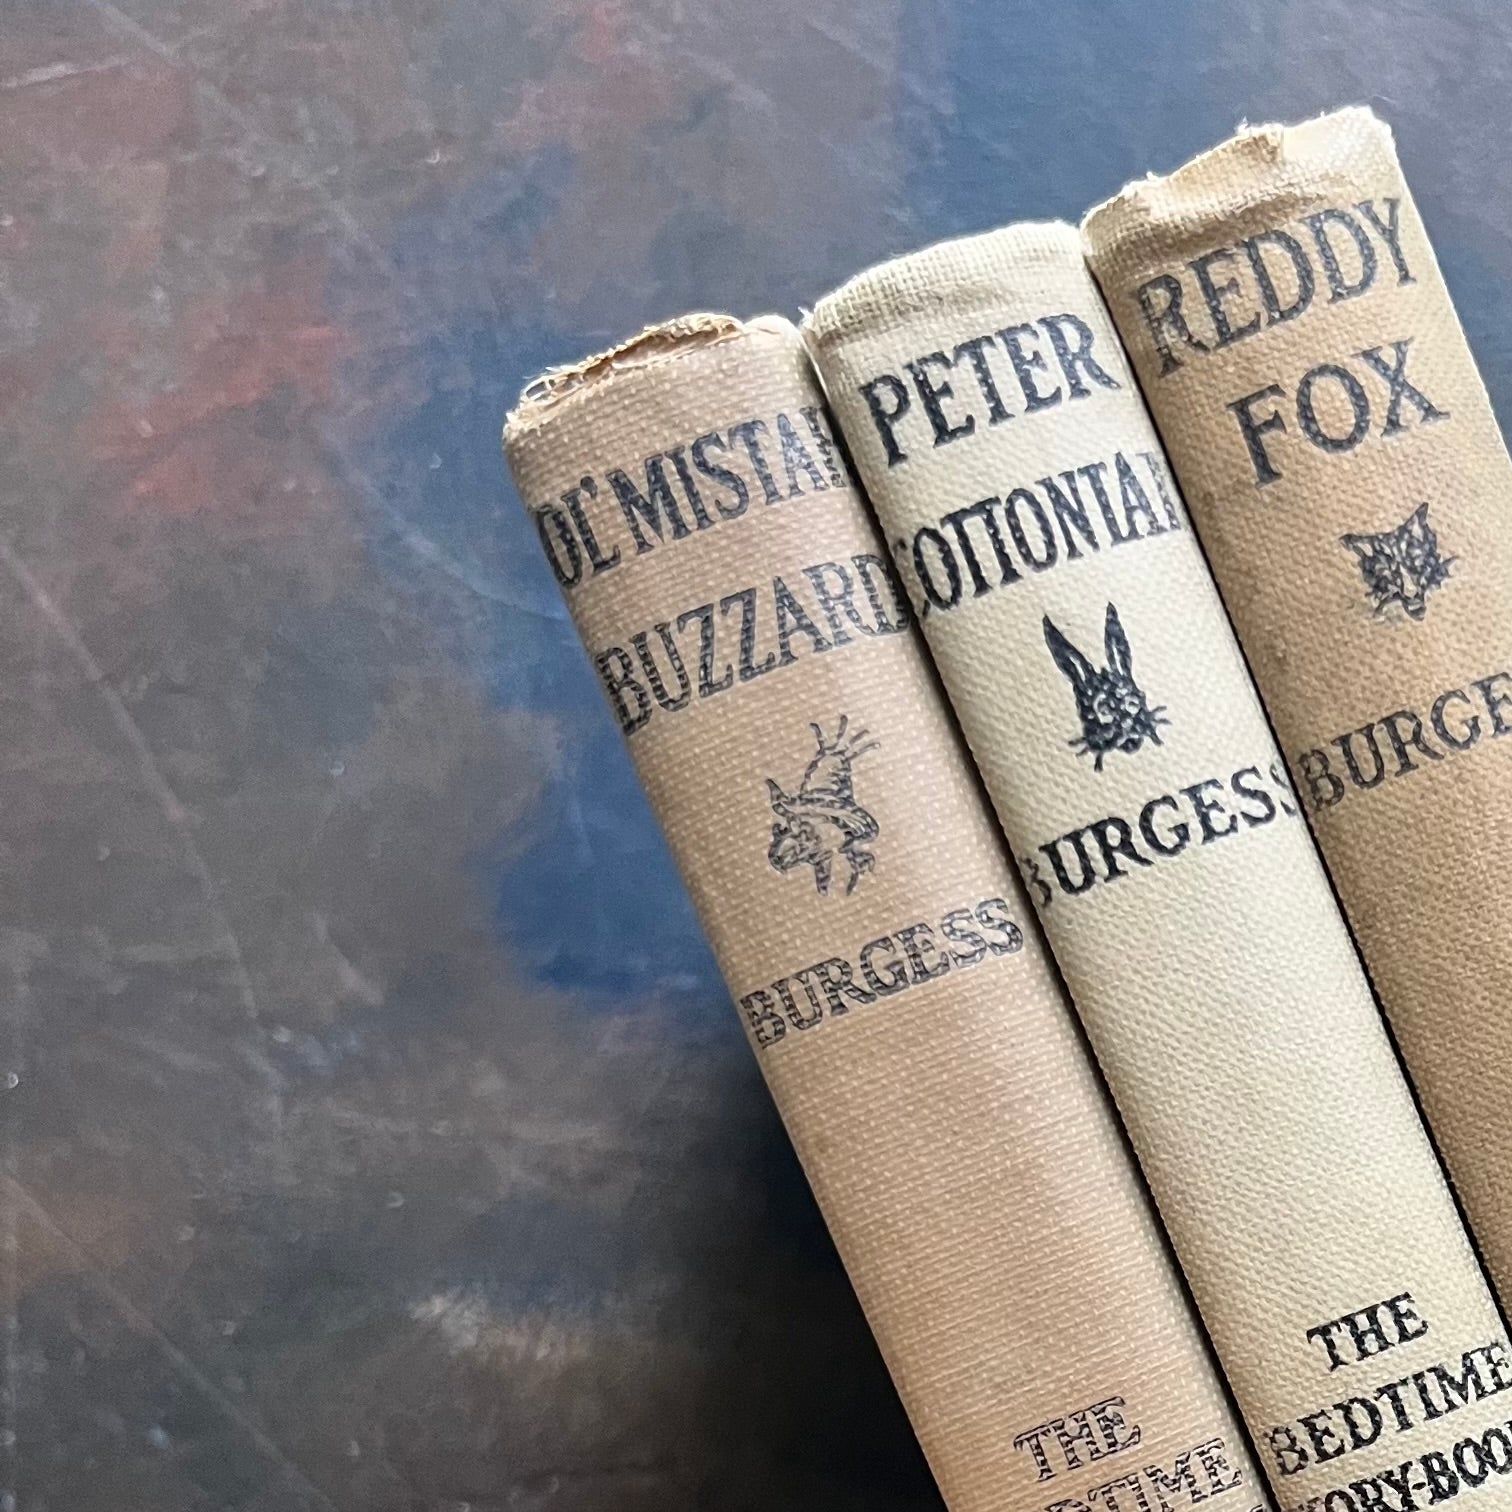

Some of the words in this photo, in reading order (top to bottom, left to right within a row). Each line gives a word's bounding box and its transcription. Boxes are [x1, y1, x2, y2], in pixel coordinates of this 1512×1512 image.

[1134, 197, 1417, 377] REDDY
[859, 313, 1122, 468] PETER
[1227, 337, 1450, 489] FOX
[893, 451, 1181, 617] OTTONTAI
[595, 553, 909, 735] BUZZARD
[740, 898, 1023, 1050] BURGESS
[1306, 1292, 1428, 1372] THE
[1013, 1396, 1141, 1482] THE
